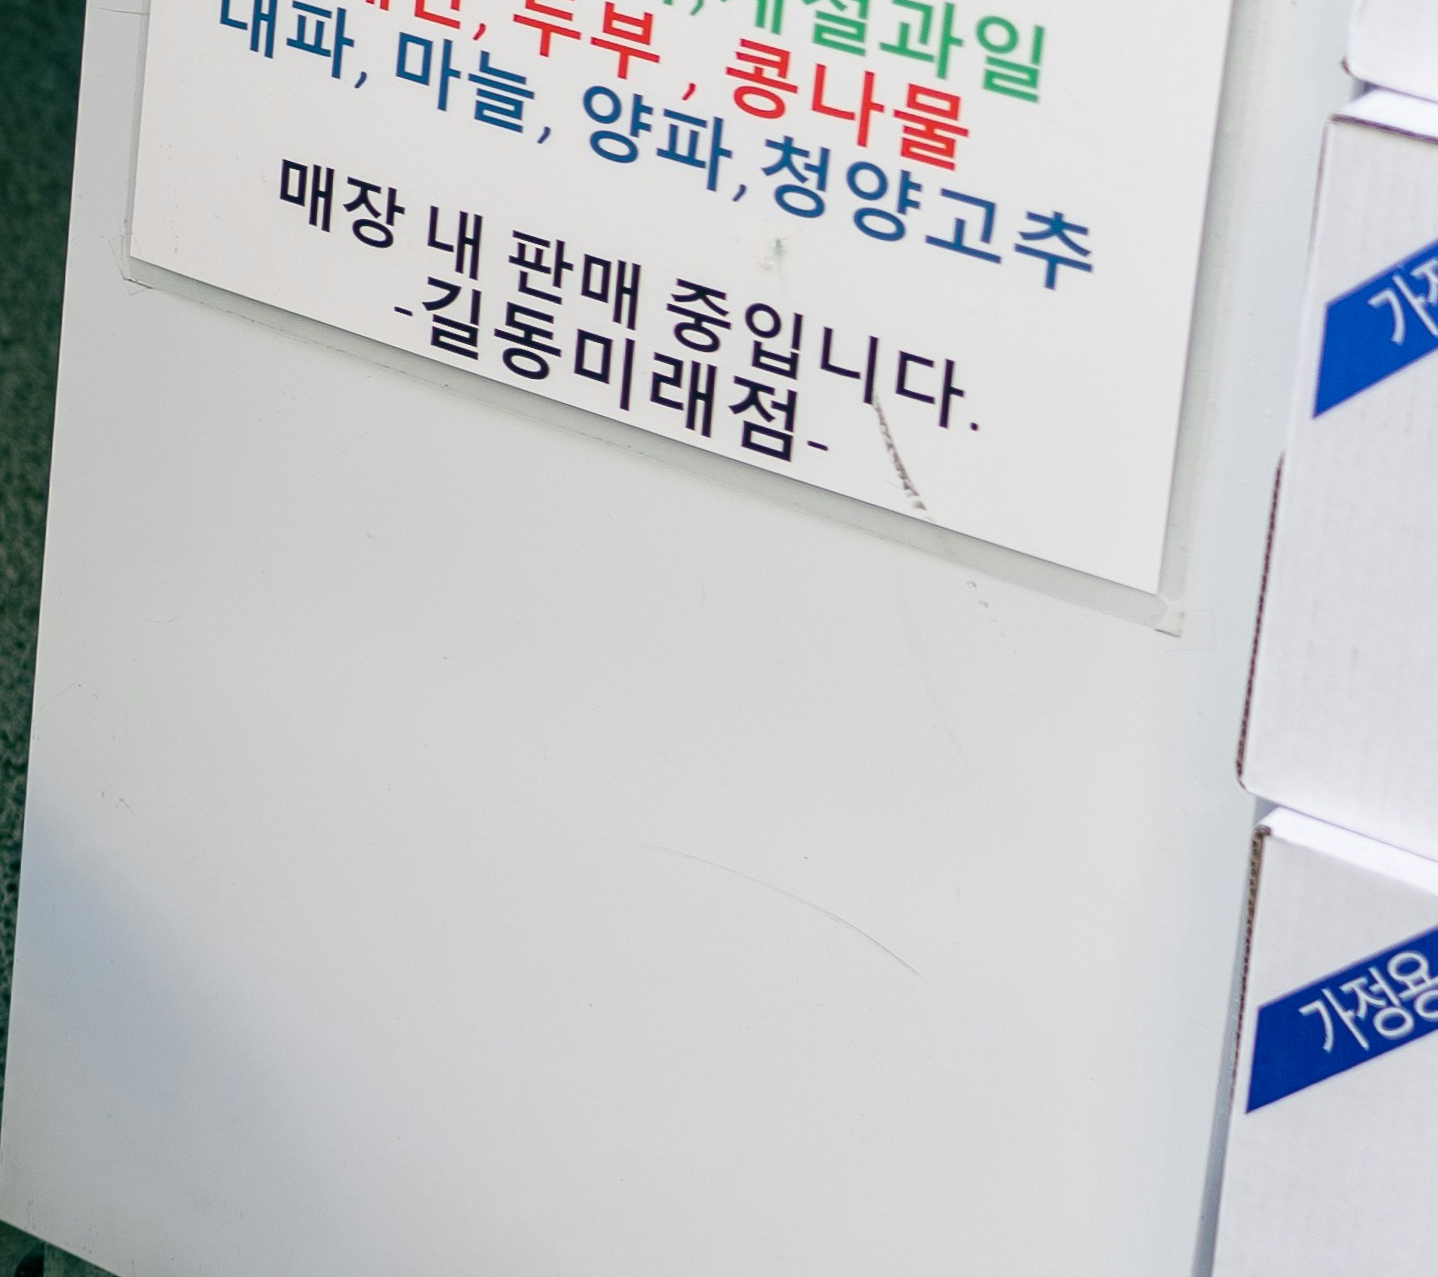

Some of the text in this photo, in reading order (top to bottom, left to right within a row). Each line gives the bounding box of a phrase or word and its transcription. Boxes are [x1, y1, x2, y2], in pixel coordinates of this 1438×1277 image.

[396, 32, 551, 144] 마늘,
[726, 39, 969, 171] 콩나물
[280, 159, 978, 431] 매장 내 판매 중입니다.
